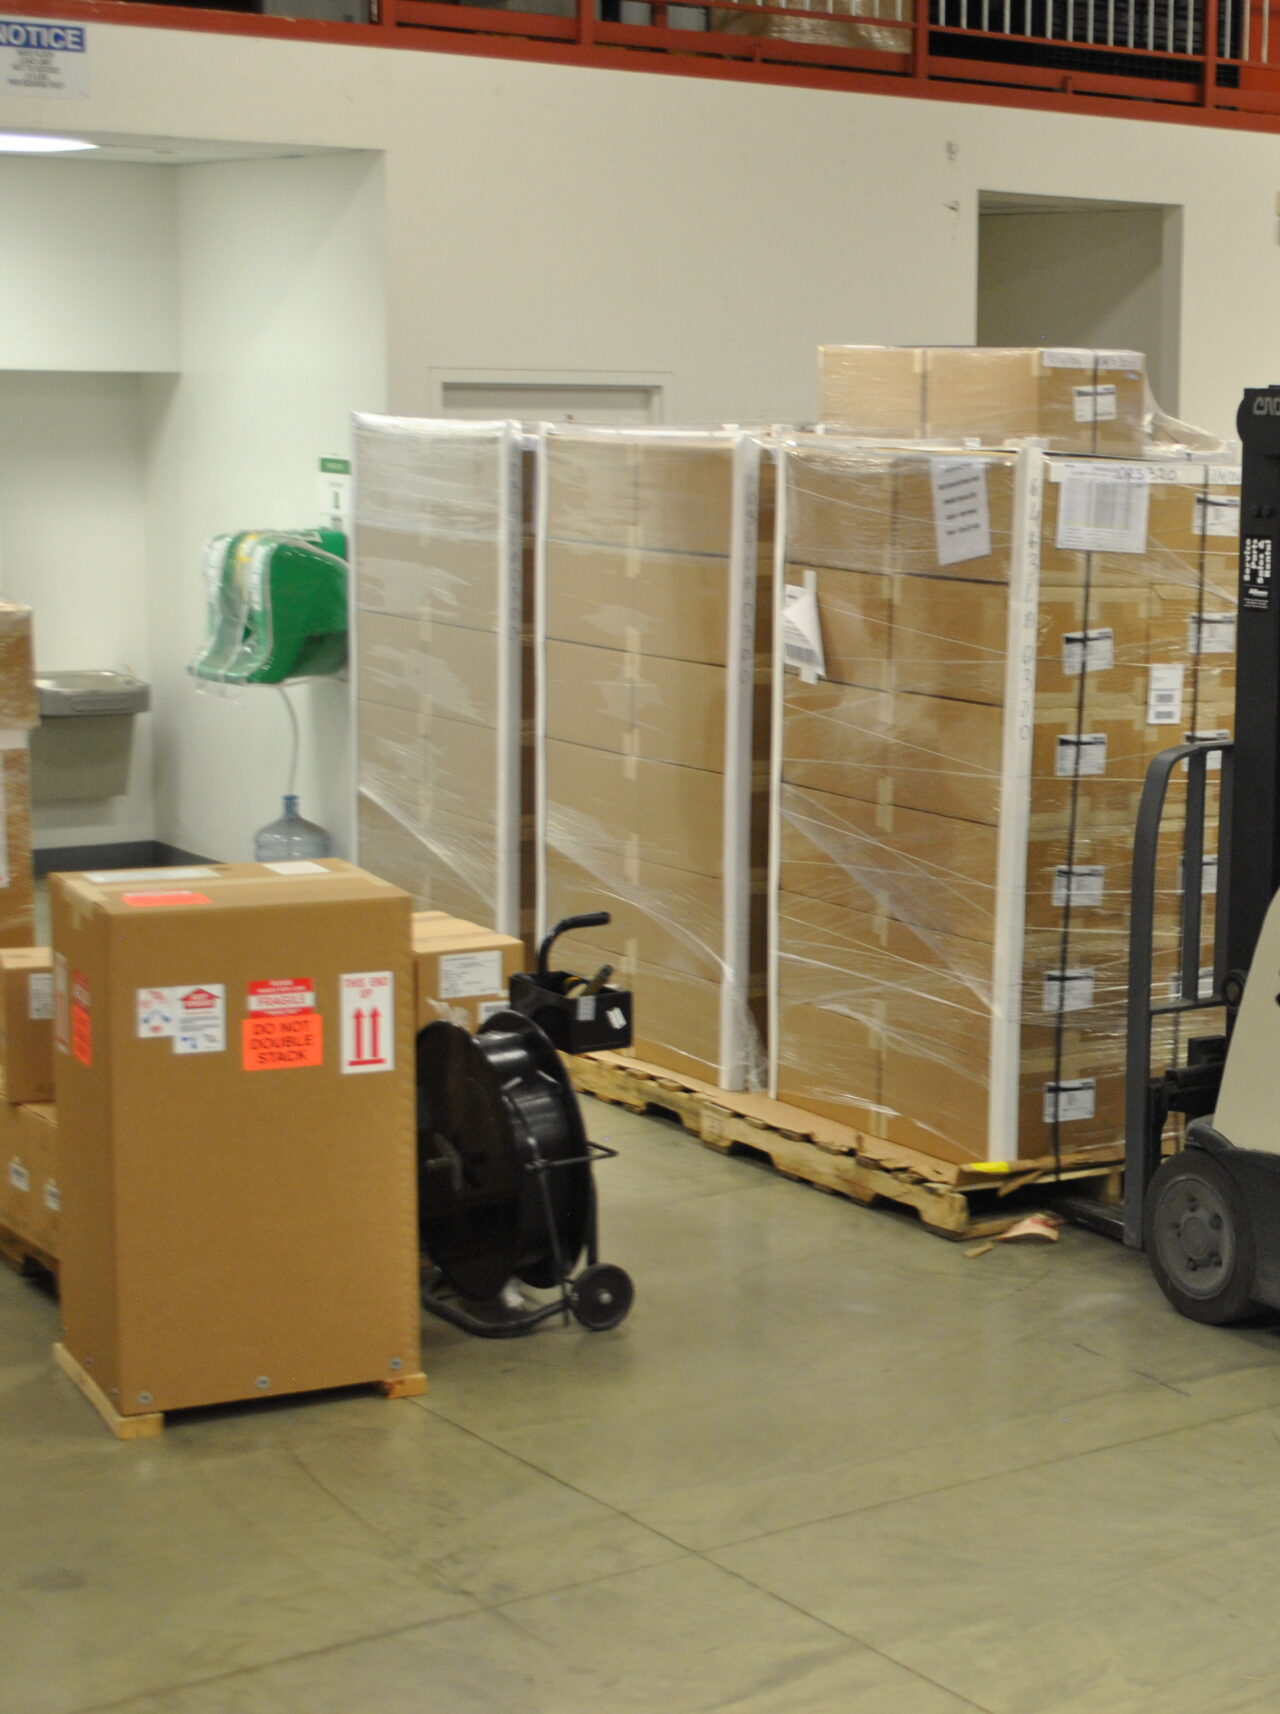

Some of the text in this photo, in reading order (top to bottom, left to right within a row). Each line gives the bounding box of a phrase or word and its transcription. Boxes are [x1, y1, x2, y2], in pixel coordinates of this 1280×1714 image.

[1243, 538, 1251, 581] Service
[1250, 538, 1258, 569] Parts
[1264, 539, 1272, 578] Rental
[256, 993, 305, 1006] FRAGILE
[252, 1020, 310, 1036] DO NOT
[250, 1034, 314, 1051] DOUBLE
[257, 1049, 308, 1065] STACK
